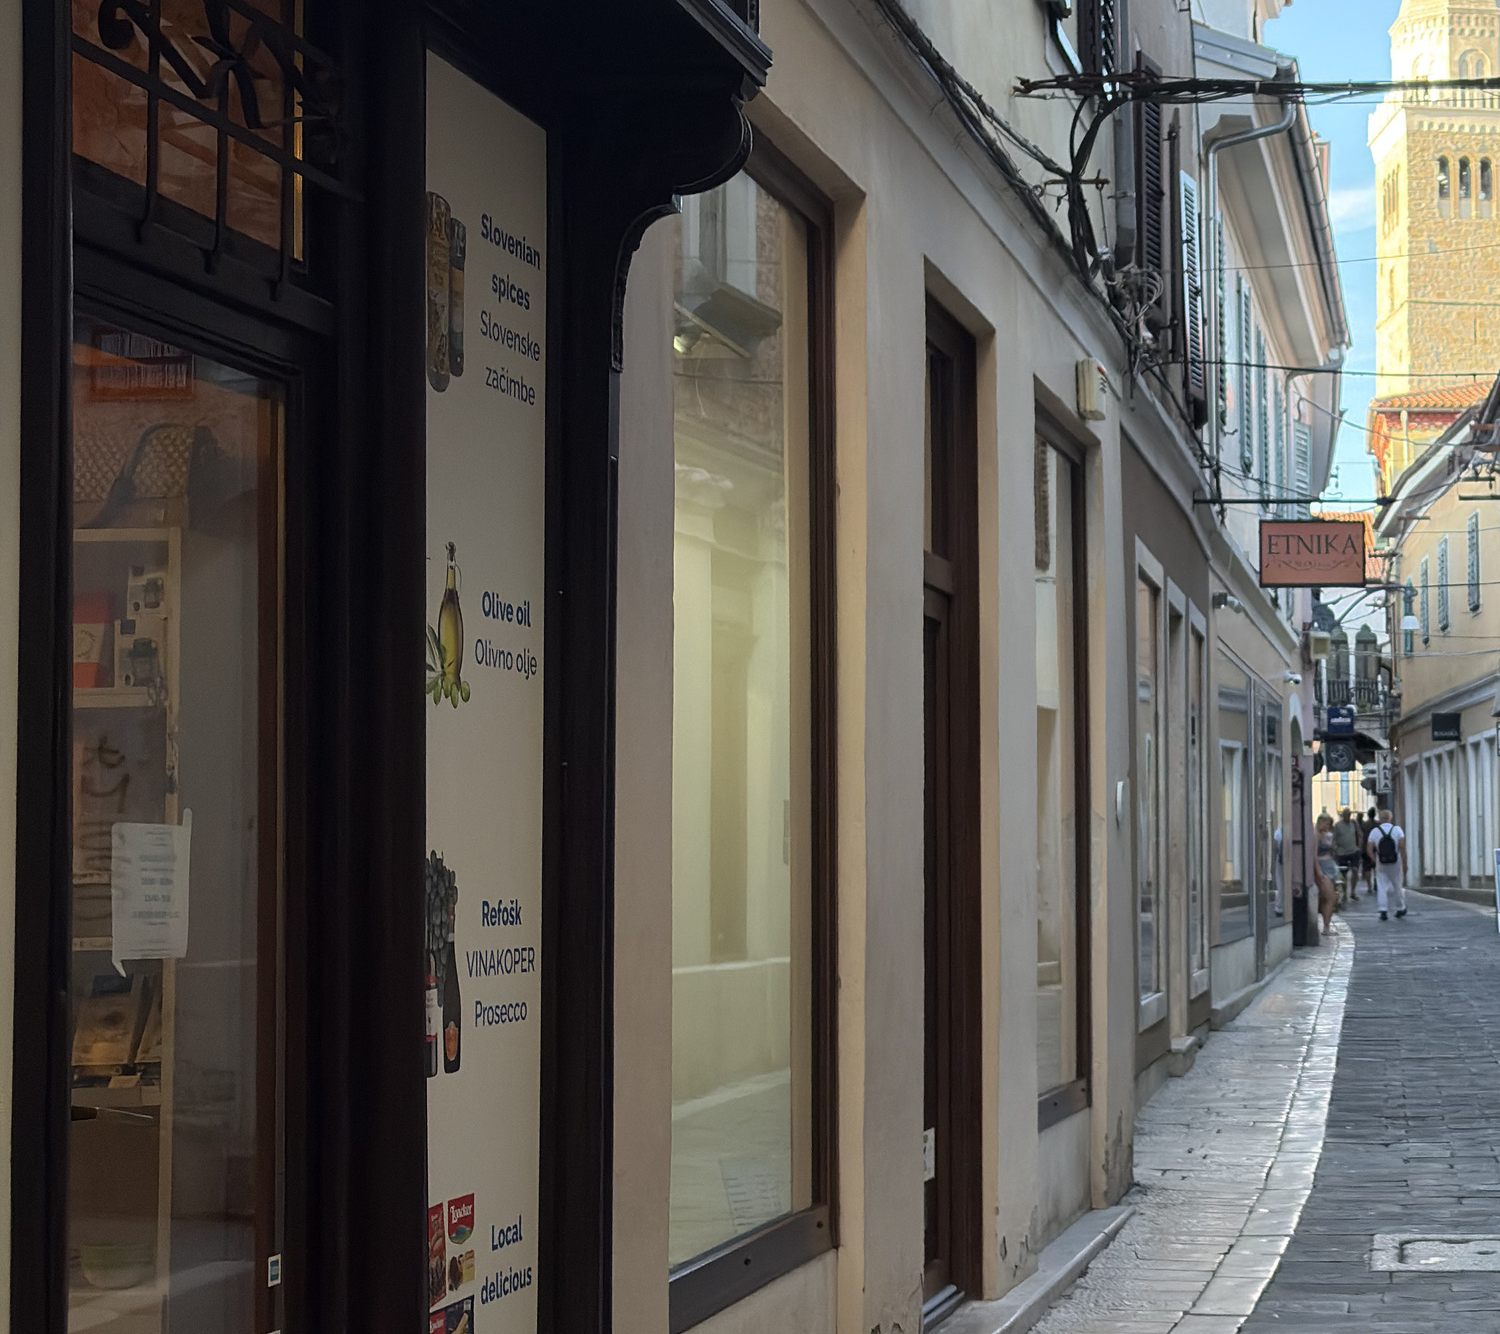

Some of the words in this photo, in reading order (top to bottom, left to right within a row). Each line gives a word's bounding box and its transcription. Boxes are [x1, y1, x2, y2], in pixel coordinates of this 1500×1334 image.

[480, 213, 541, 270] Slovenian
[491, 273, 531, 310] spices
[480, 310, 541, 362] Slovenske
[485, 366, 536, 406] začimbe
[1267, 534, 1358, 555] ETNIKA
[482, 591, 514, 622] Olive
[516, 600, 531, 627] oil
[475, 638, 513, 671] Olivno
[516, 648, 537, 680] olje
[481, 899, 522, 927] Refošk
[466, 947, 536, 978] VINAKOPER
[475, 1000, 528, 1028] Prosecco
[491, 1214, 523, 1252] Local
[480, 1266, 532, 1305] delicious
